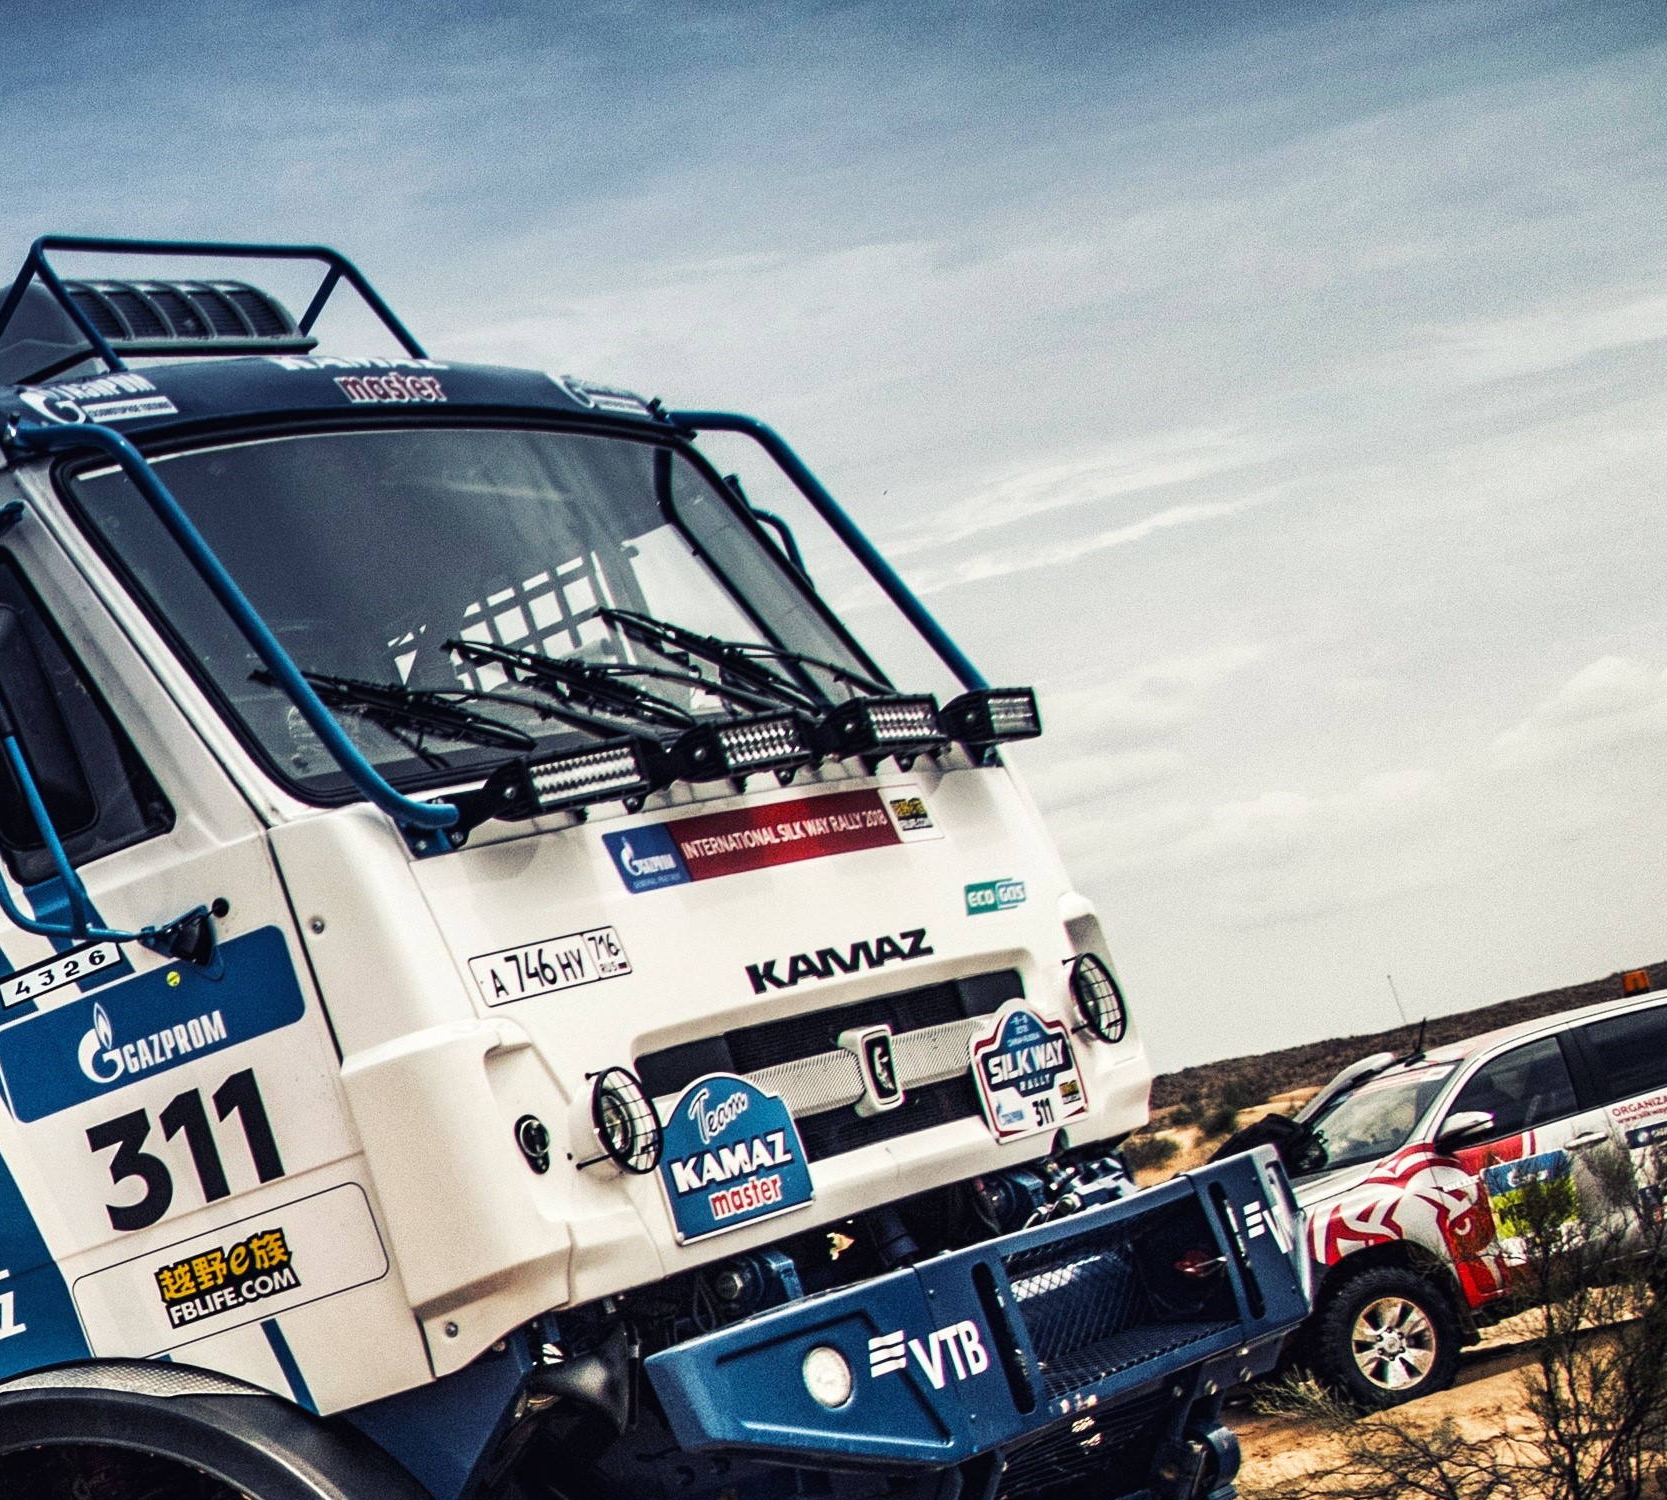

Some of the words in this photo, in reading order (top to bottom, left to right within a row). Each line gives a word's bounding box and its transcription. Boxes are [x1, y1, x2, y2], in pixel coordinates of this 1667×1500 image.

[334, 372, 448, 404] master
[680, 825, 779, 860] INTERNATIONAL
[776, 819, 803, 843] SILK
[803, 815, 830, 837] WAY
[828, 811, 865, 835] RALLY
[863, 808, 887, 828] 2018
[14, 949, 107, 996] 4326
[587, 933, 621, 961] 716
[745, 927, 934, 995] KAMAZ
[122, 1009, 228, 1074] GAZPROM
[987, 1047, 1033, 1085] SILK
[1030, 1038, 1064, 1072] WAY
[687, 1087, 749, 1145] Team
[1032, 1097, 1055, 1127] 311
[85, 1067, 286, 1232] 311
[670, 1131, 793, 1194] KAMAZ
[709, 1174, 783, 1221] master
[158, 1232, 289, 1301] 越野e族
[169, 1267, 296, 1325] FBLIFE.COM
[907, 1319, 990, 1390] VTB
